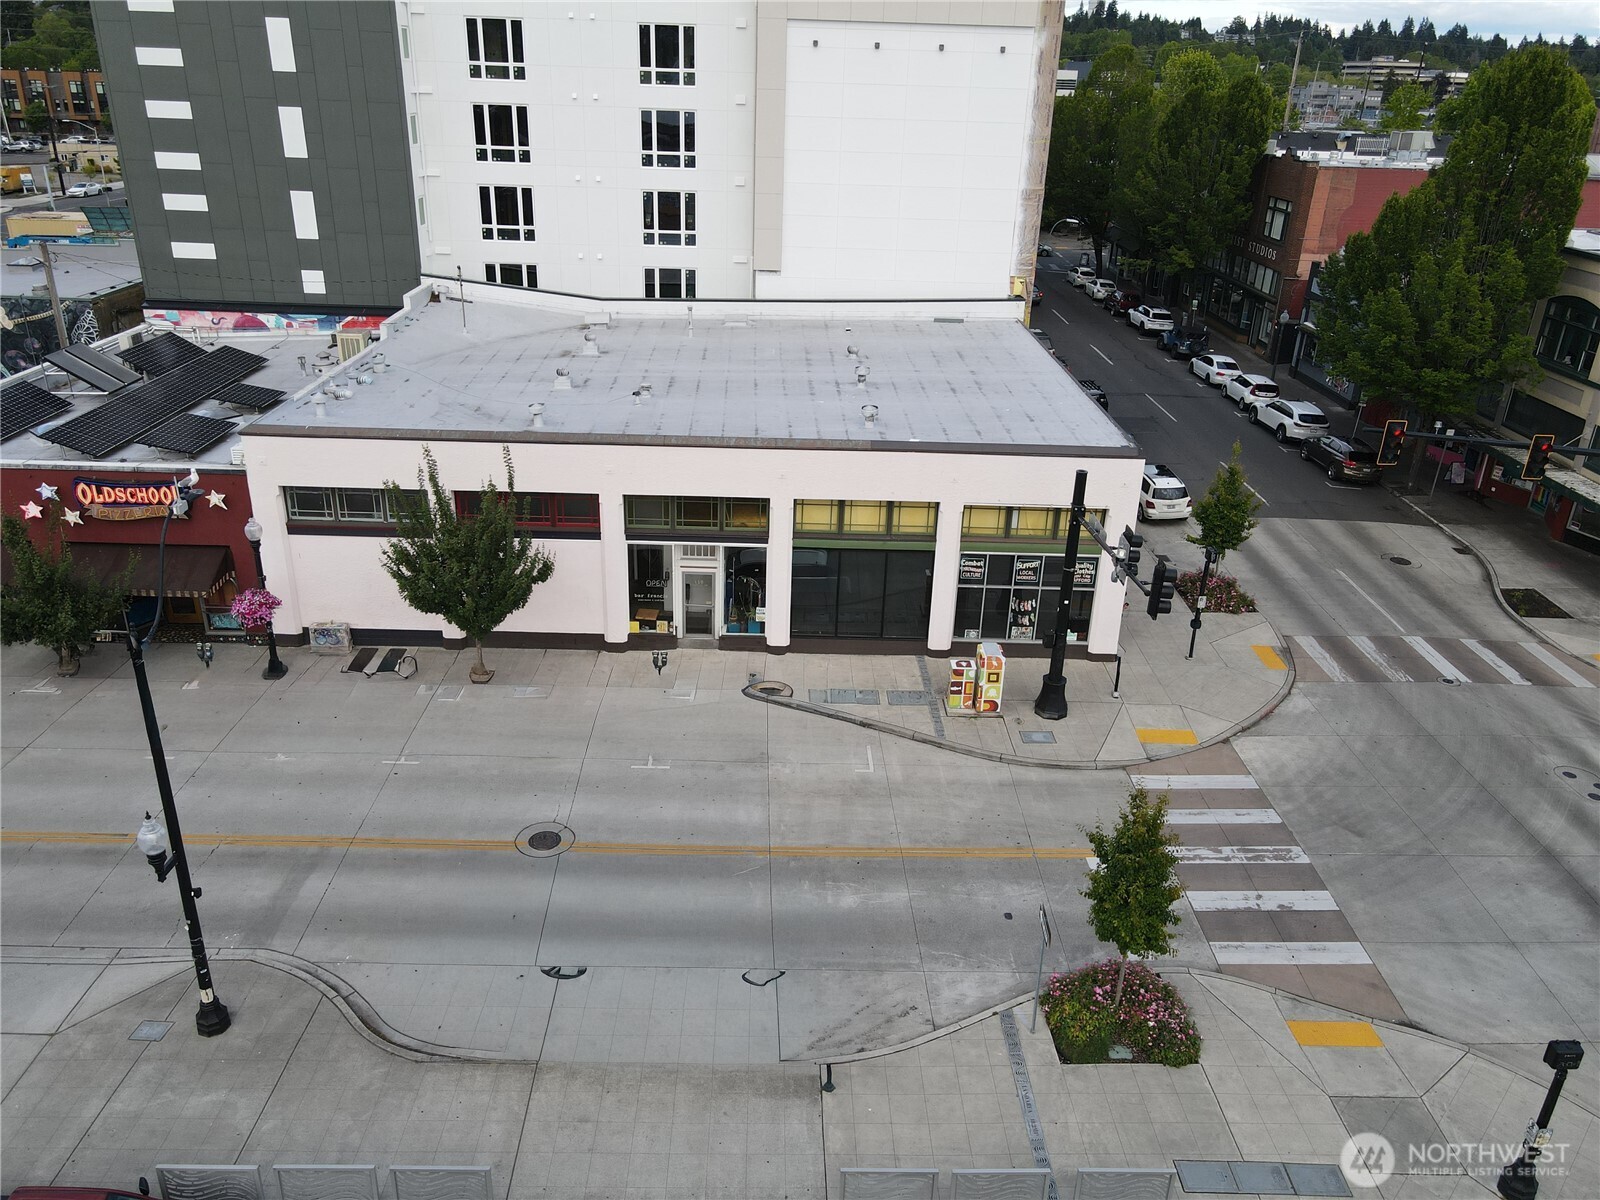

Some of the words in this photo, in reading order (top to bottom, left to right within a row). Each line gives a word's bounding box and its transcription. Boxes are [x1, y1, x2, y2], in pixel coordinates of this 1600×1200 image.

[1248, 241, 1277, 261] STUDIOS
[98, 506, 169, 520] PIZZERIA
[961, 559, 984, 567] Combat
[646, 579, 667, 588] OPEN
